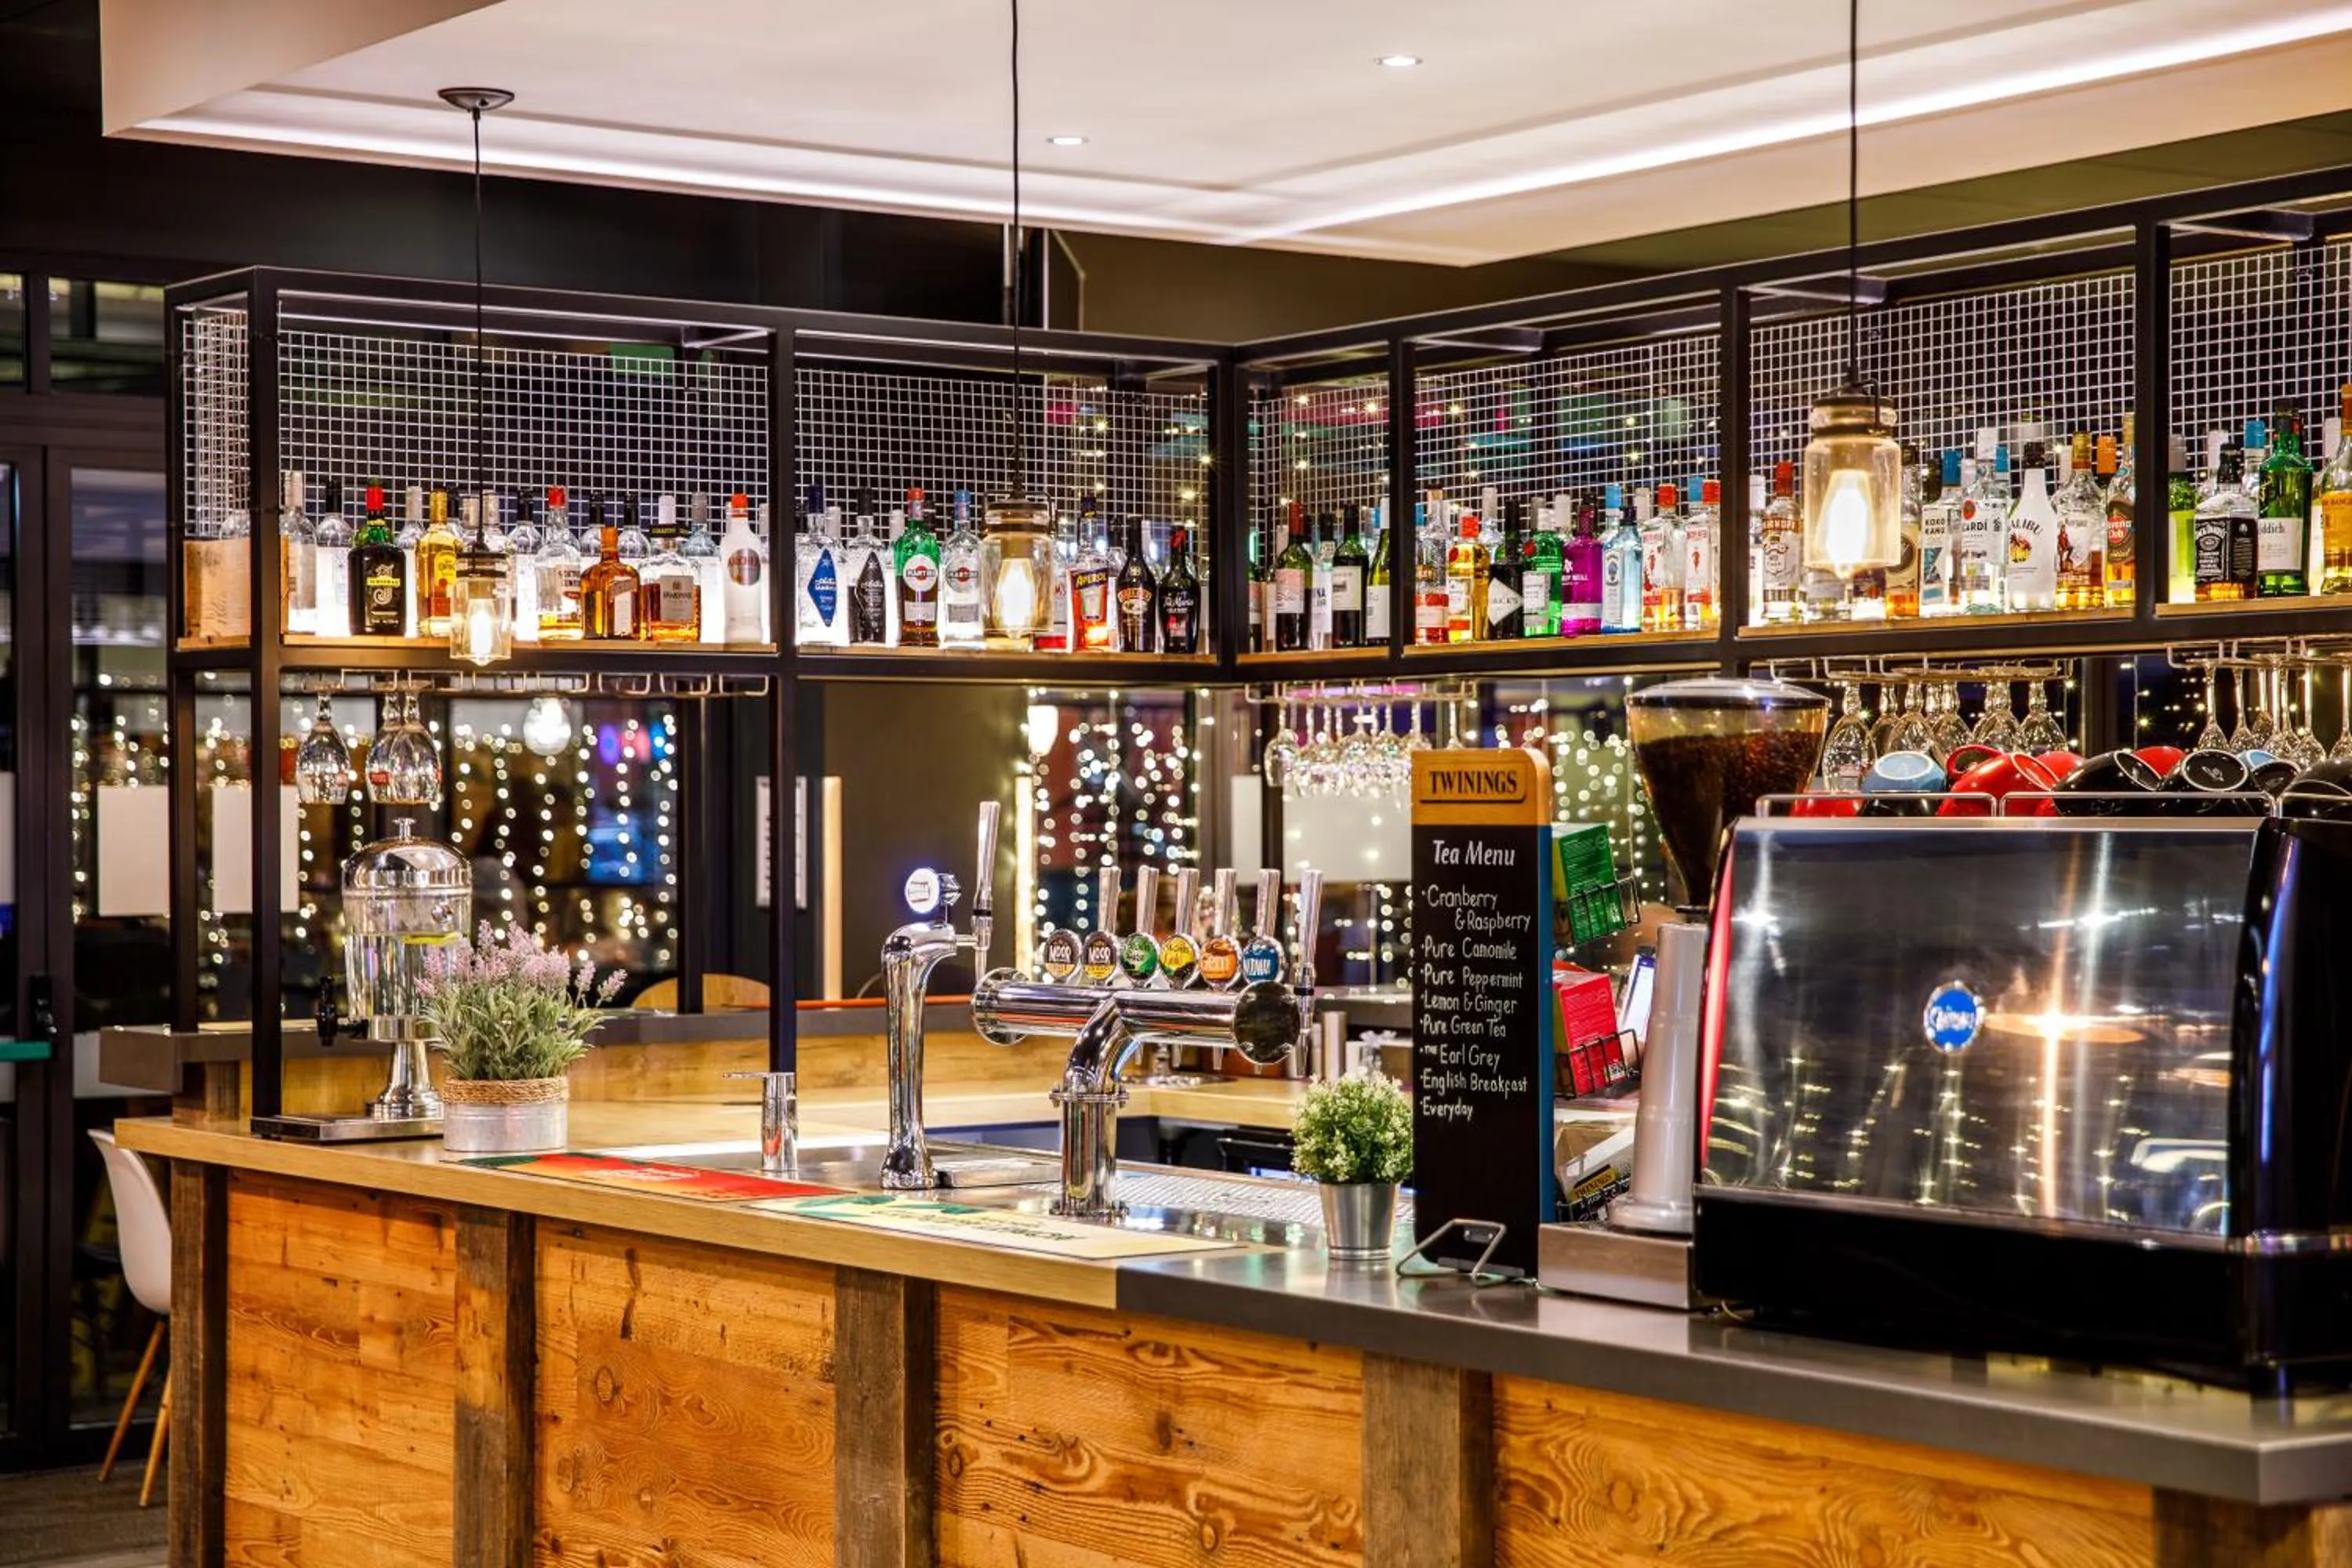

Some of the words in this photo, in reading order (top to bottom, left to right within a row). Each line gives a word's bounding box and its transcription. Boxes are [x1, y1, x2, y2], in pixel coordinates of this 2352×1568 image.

[1429, 771, 1518, 794] TWININGS
[1433, 840, 1460, 865] Tea
[1465, 840, 1515, 866] Menu
[1427, 884, 1498, 910] Cranberry
[1425, 935, 1455, 959] Pure
[1462, 937, 1517, 960] Camomile
[1425, 963, 1455, 985] Pure
[1462, 965, 1523, 993] Peppermint
[1424, 989, 1460, 1011] Lemon
[1423, 1014, 1447, 1035] Pure
[1451, 1015, 1483, 1034] Green
[1486, 1018, 1506, 1037] Tea
[1440, 1044, 1465, 1065] Earl
[1468, 1044, 1501, 1073] Grey
[1423, 1068, 1467, 1096] English
[1470, 1073, 1527, 1100] Breakfast
[1423, 1095, 1473, 1122] Everyday
